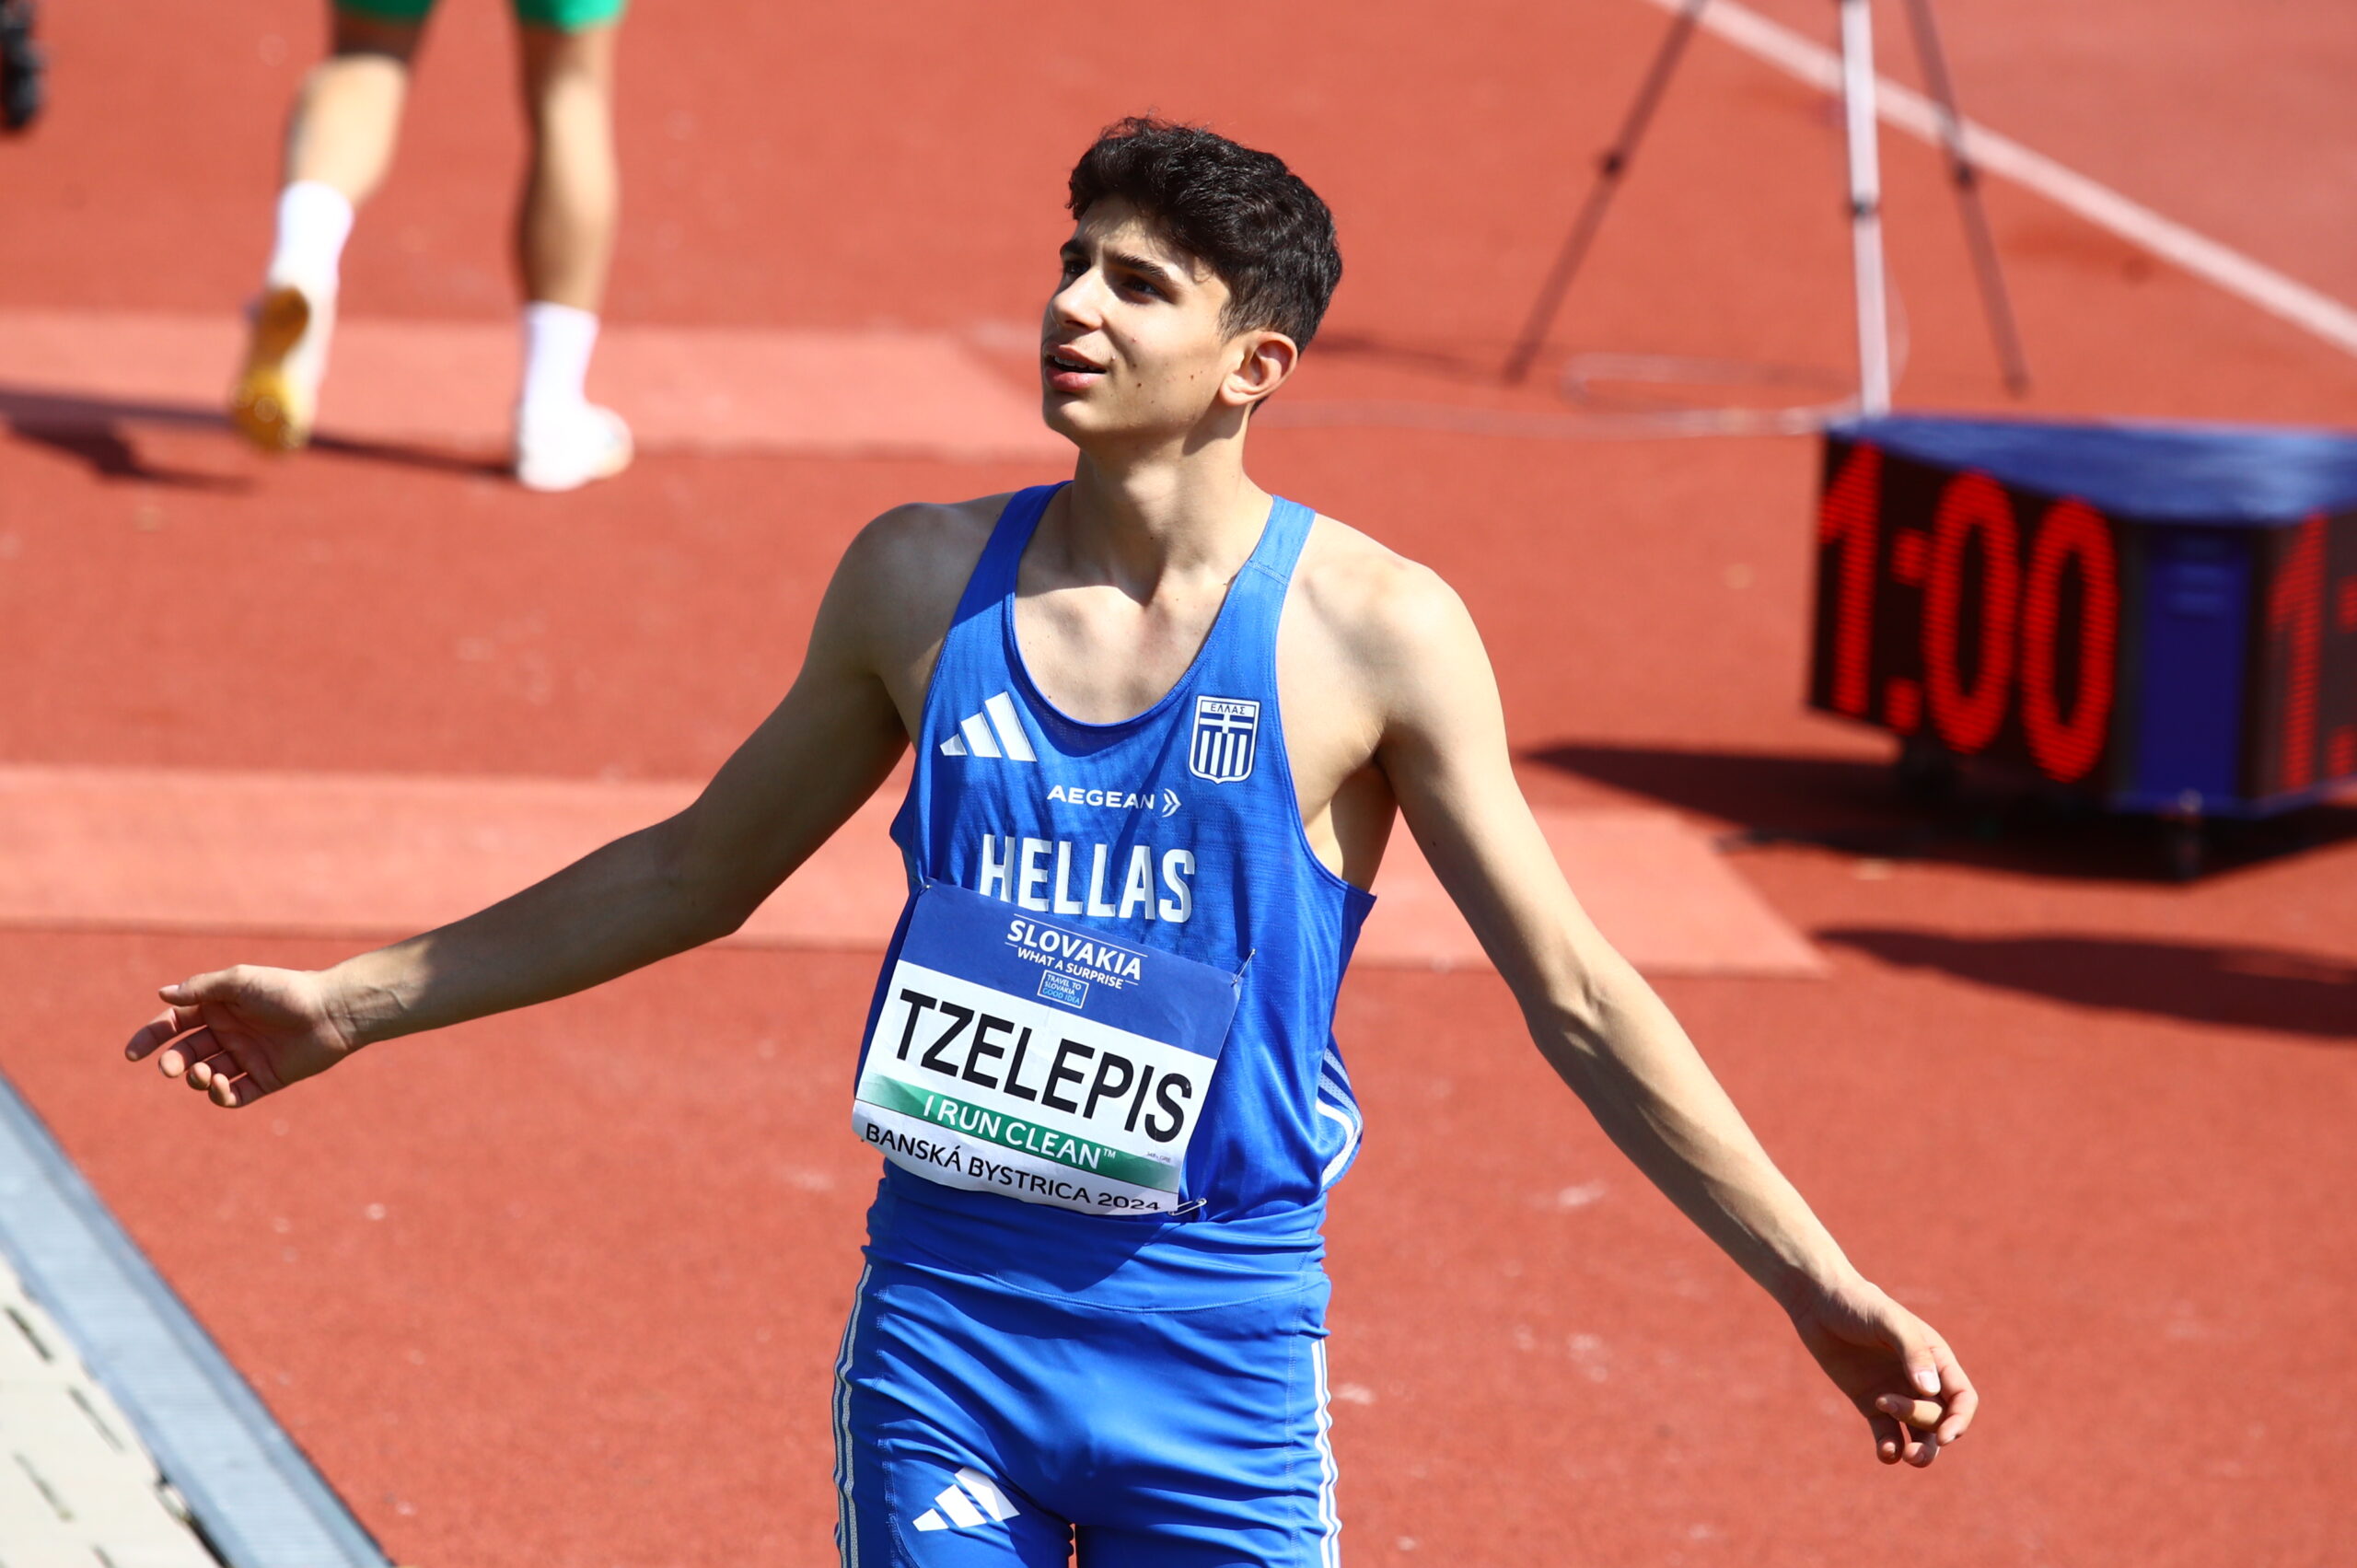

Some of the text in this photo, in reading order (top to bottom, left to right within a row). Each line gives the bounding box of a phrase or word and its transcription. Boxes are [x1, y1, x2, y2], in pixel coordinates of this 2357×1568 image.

[1817, 437, 2121, 784] 1:00
[1210, 703, 1246, 715] ΕΛΛΑΣ
[1046, 784, 1155, 810] AEGEAN
[979, 833, 1196, 923] HELLAS
[1006, 920, 1142, 981] SLOVAKIA
[1017, 947, 1124, 989] WHAT A SURPRISE
[1042, 988, 1080, 1005] GOOD IDEA
[1044, 981, 1075, 995] SLOVAKIA
[1047, 974, 1082, 991] TRAVEL TO
[896, 987, 1193, 1144] TZELEPIS
[923, 1097, 935, 1118] I
[937, 1103, 1001, 1138] RUN
[865, 1122, 1162, 1212] BANSKÁ BYSTRICA 2024
